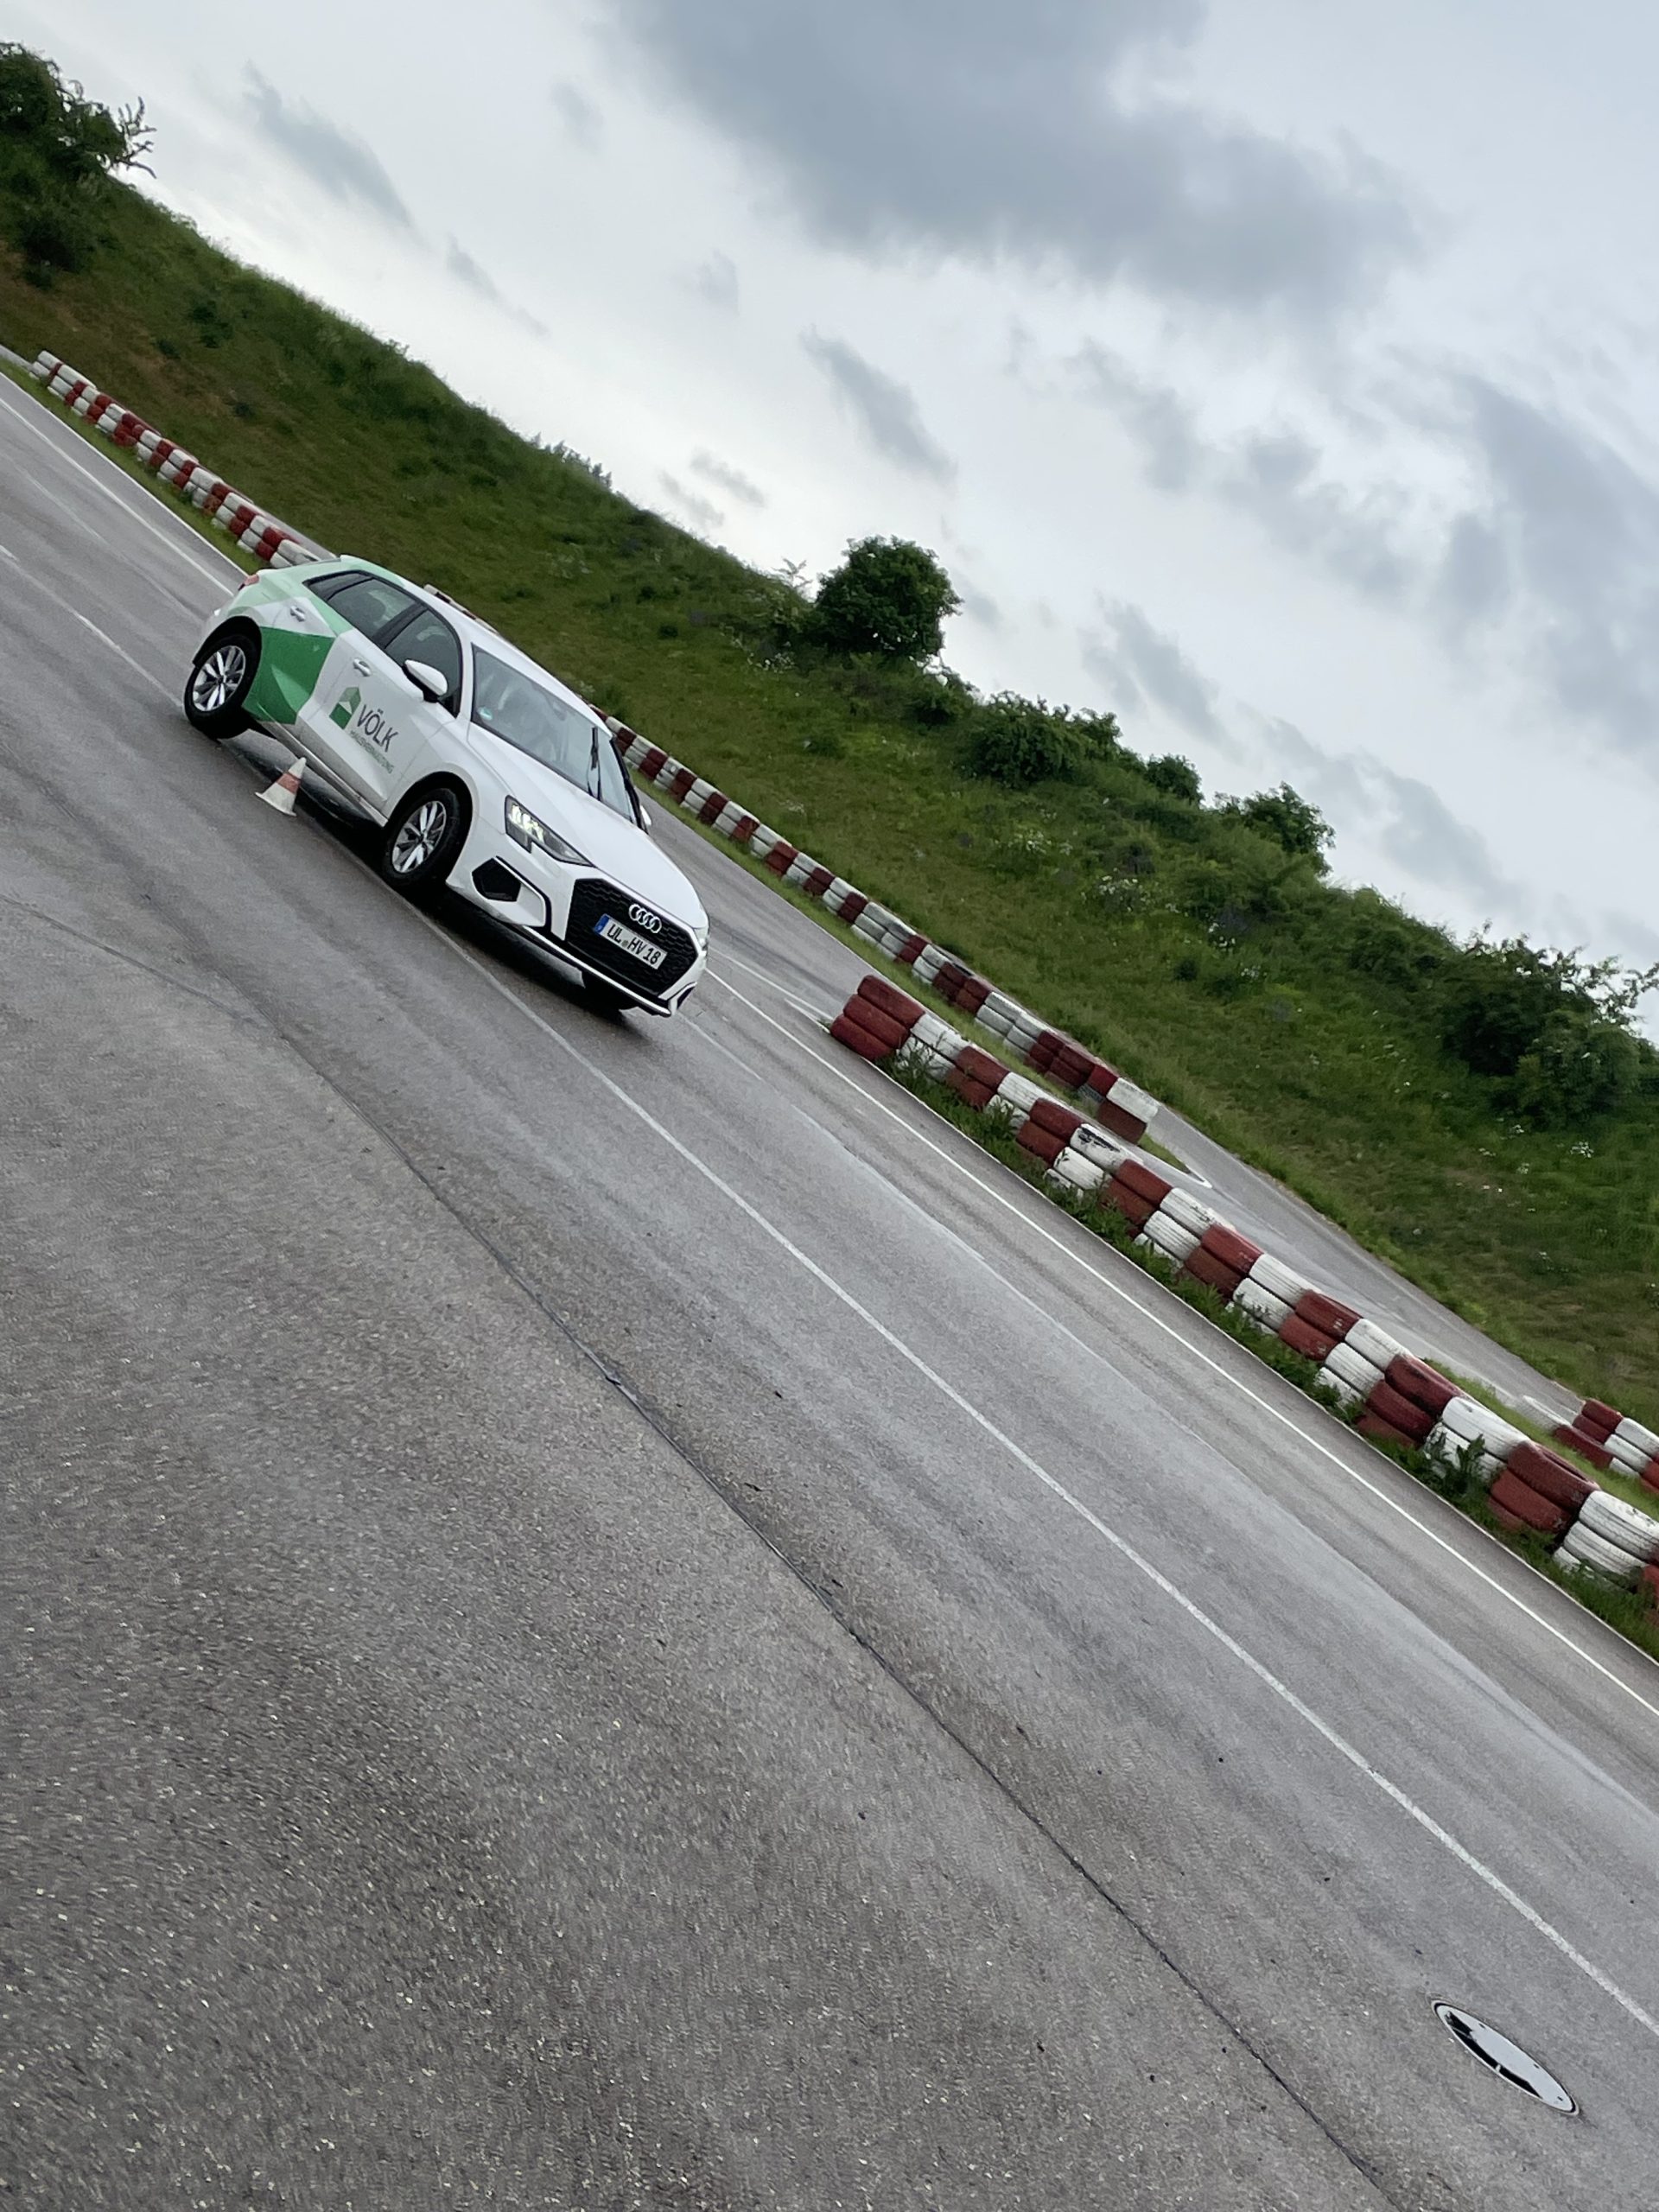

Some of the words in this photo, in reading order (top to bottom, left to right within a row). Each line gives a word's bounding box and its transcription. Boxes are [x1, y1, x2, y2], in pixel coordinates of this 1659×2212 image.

[357, 704, 398, 753] VÖLK
[607, 924, 622, 944] UL
[627, 937, 647, 956] HV
[642, 948, 662, 964] 18
